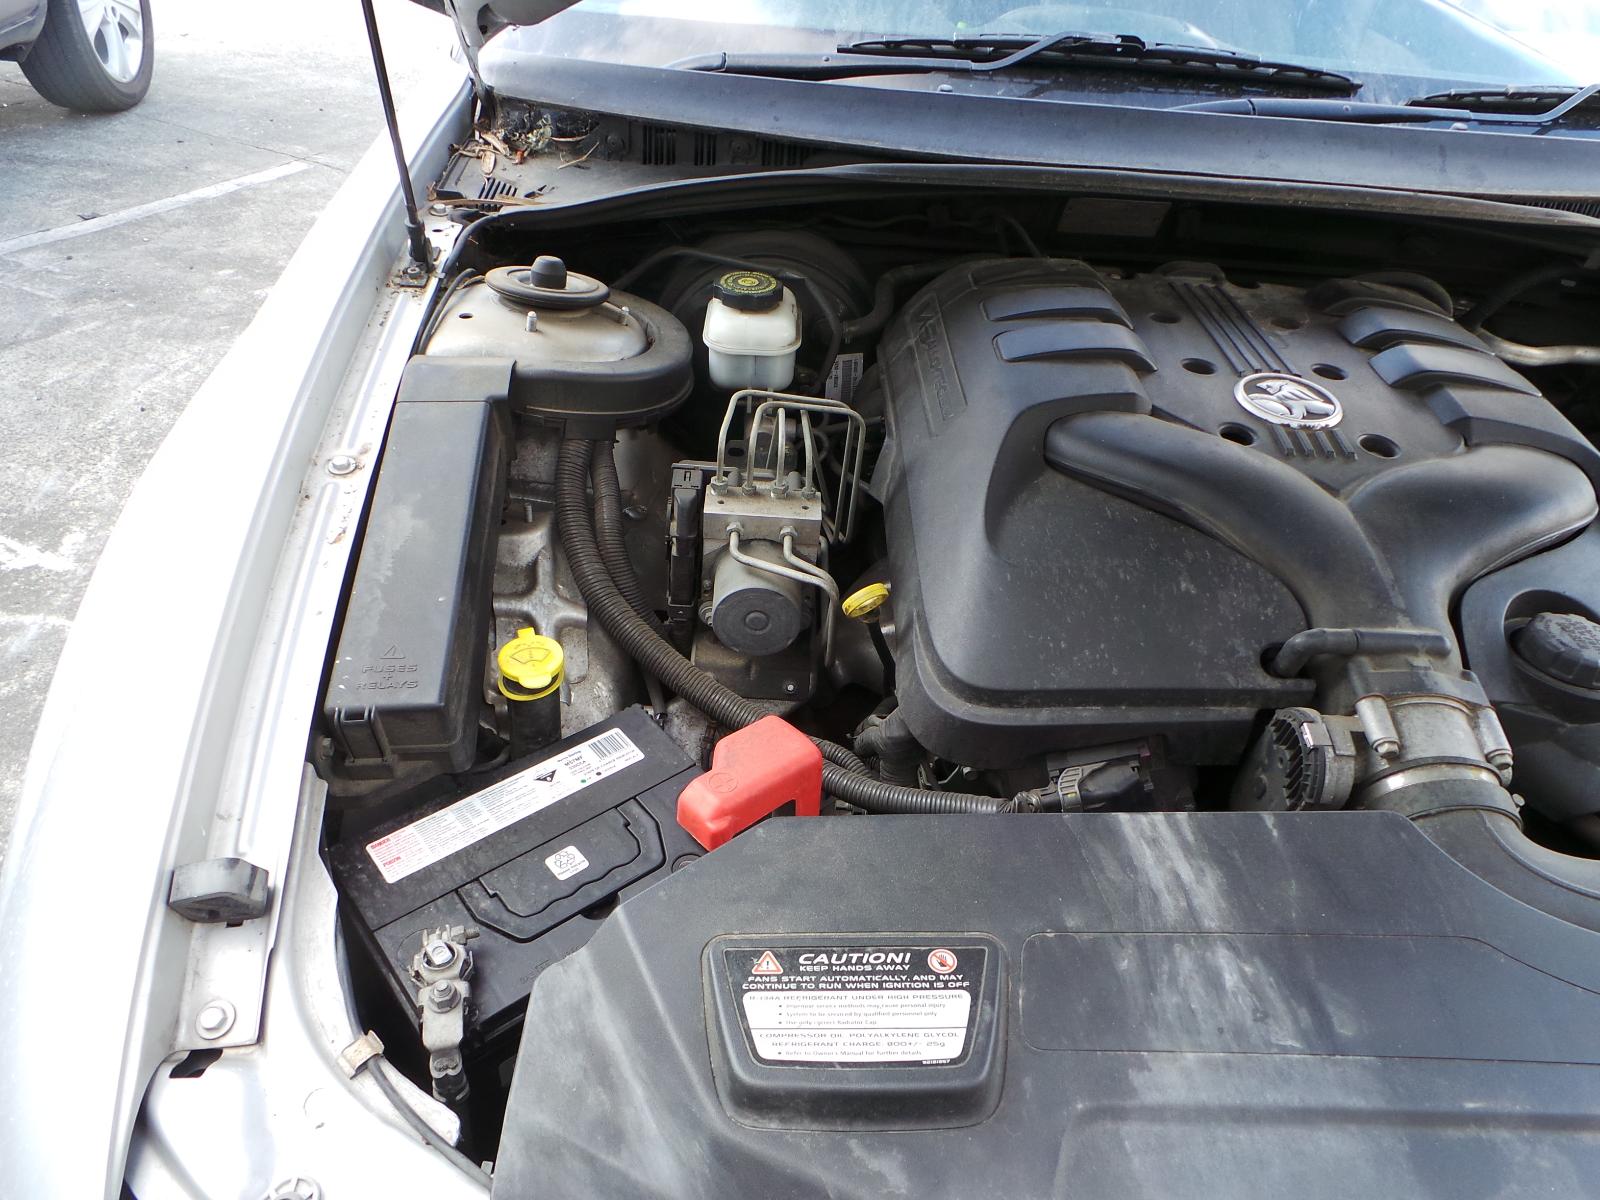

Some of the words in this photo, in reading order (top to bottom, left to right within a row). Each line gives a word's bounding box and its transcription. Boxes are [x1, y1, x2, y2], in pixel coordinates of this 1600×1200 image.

[362, 664, 418, 673] FUSES
[356, 681, 418, 690] RELAYS
[798, 953, 911, 964] CAUTION!
